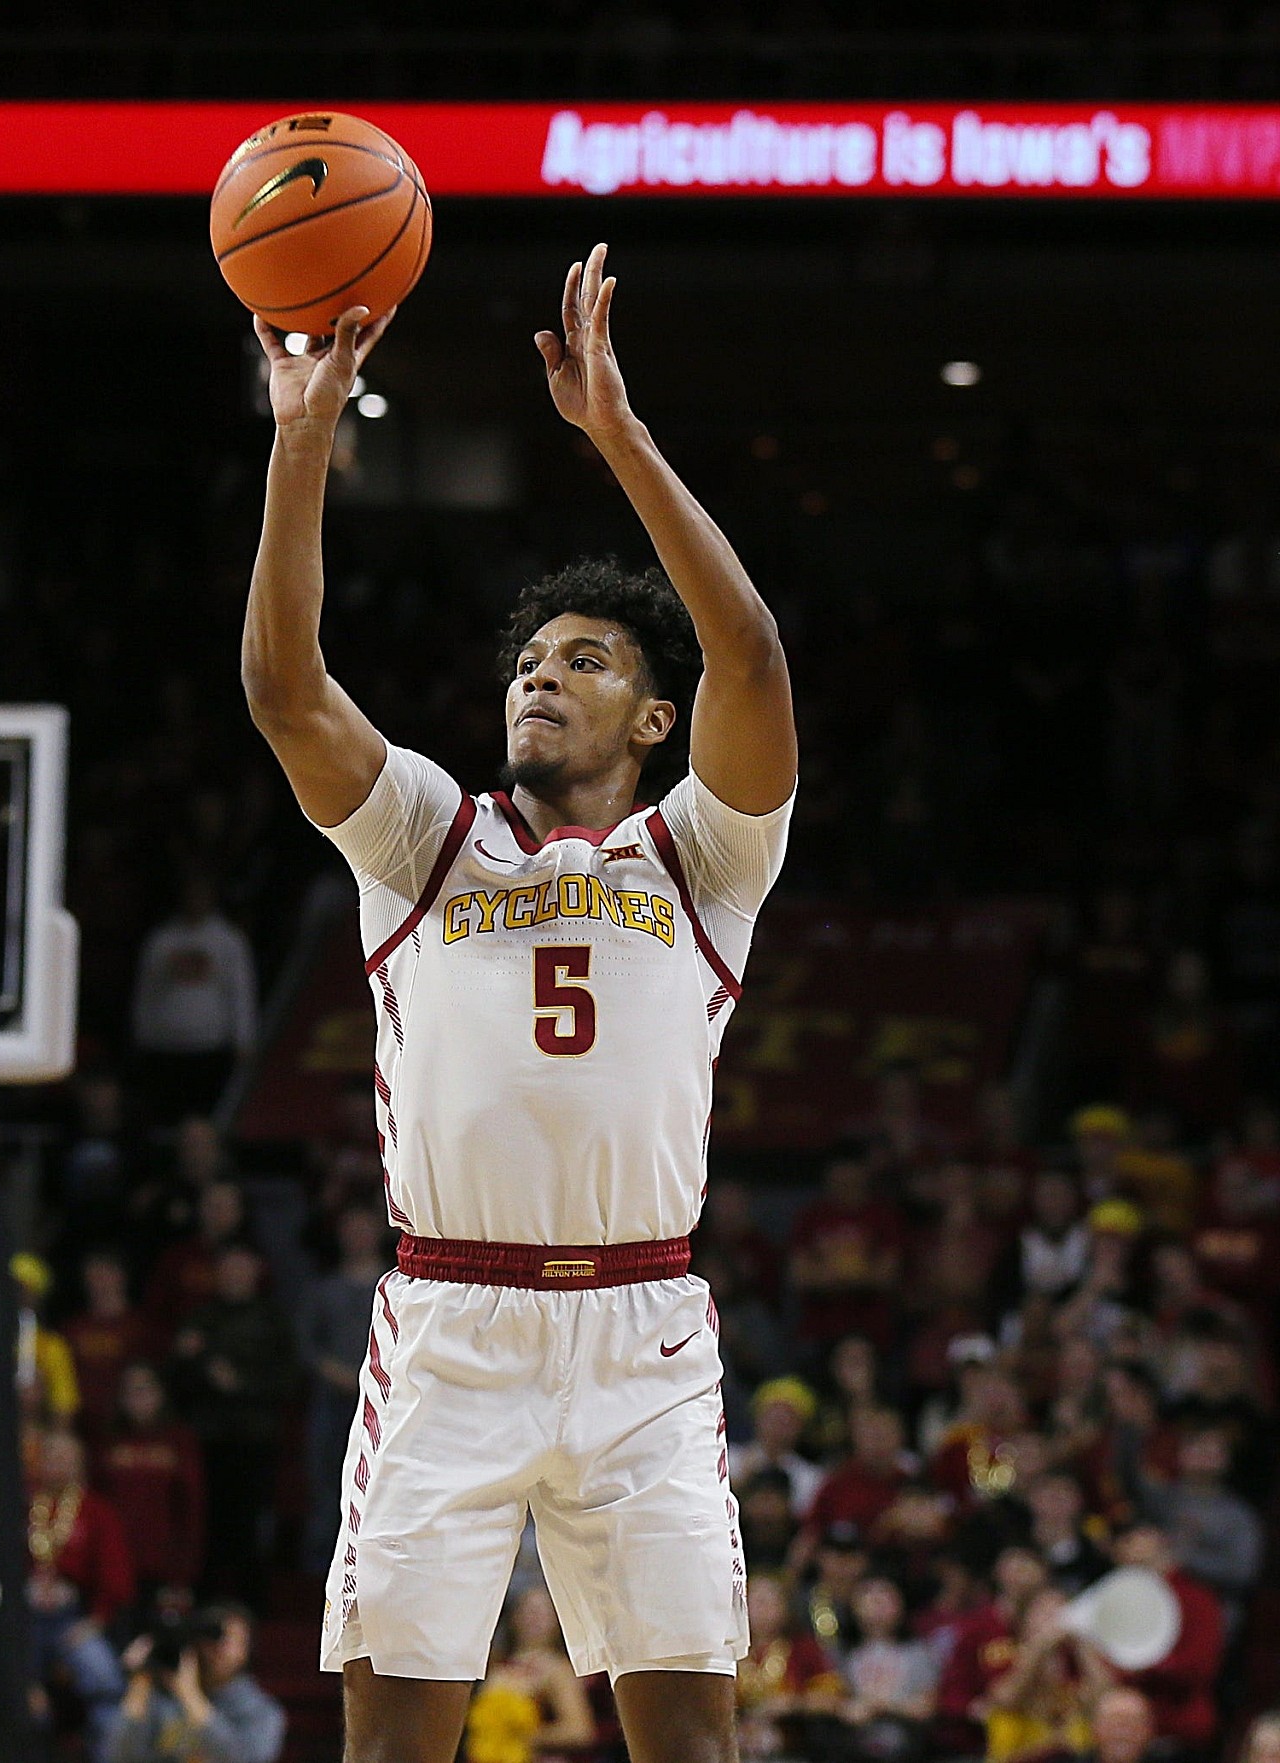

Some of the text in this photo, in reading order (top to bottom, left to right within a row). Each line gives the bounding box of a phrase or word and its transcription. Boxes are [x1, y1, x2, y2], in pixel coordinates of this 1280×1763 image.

[541, 110, 877, 194] Agriculture
[883, 110, 947, 187] is
[953, 110, 1151, 187] Iowa's
[443, 873, 675, 948] CYCLONES
[532, 944, 597, 1058] 5
[541, 1269, 570, 1278] HILTON
